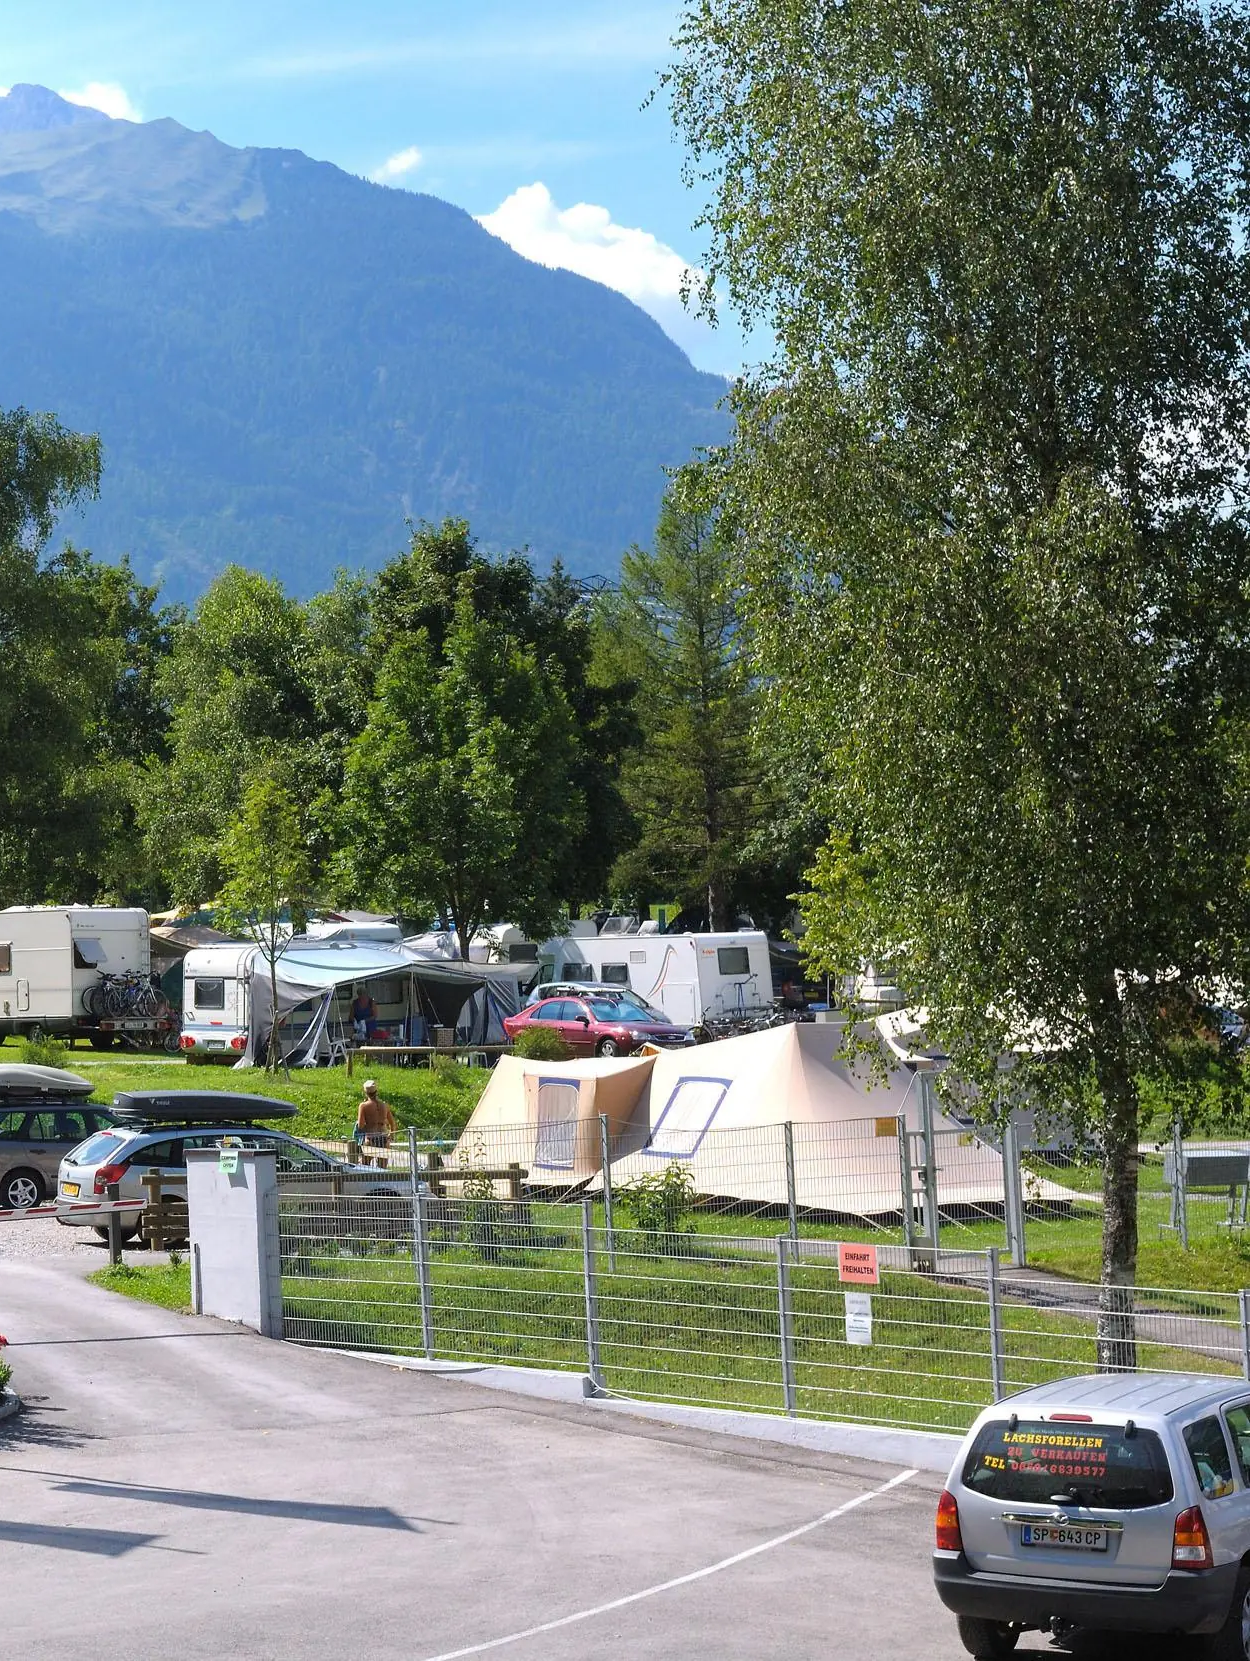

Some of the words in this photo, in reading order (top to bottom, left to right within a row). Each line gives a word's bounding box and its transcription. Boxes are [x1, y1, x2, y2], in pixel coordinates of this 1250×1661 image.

[845, 1252, 870, 1262] EINFAHRT
[842, 1265, 874, 1275] FREIHALTEN
[1003, 1432, 1103, 1448] LACHSFORELLEN
[1007, 1446, 1023, 1457] ZU
[1031, 1448, 1107, 1462] VERKAUFEN
[984, 1455, 1006, 1470] TEL
[1033, 1528, 1049, 1541] SP
[1058, 1530, 1082, 1544] 643
[1085, 1532, 1101, 1545] CP
